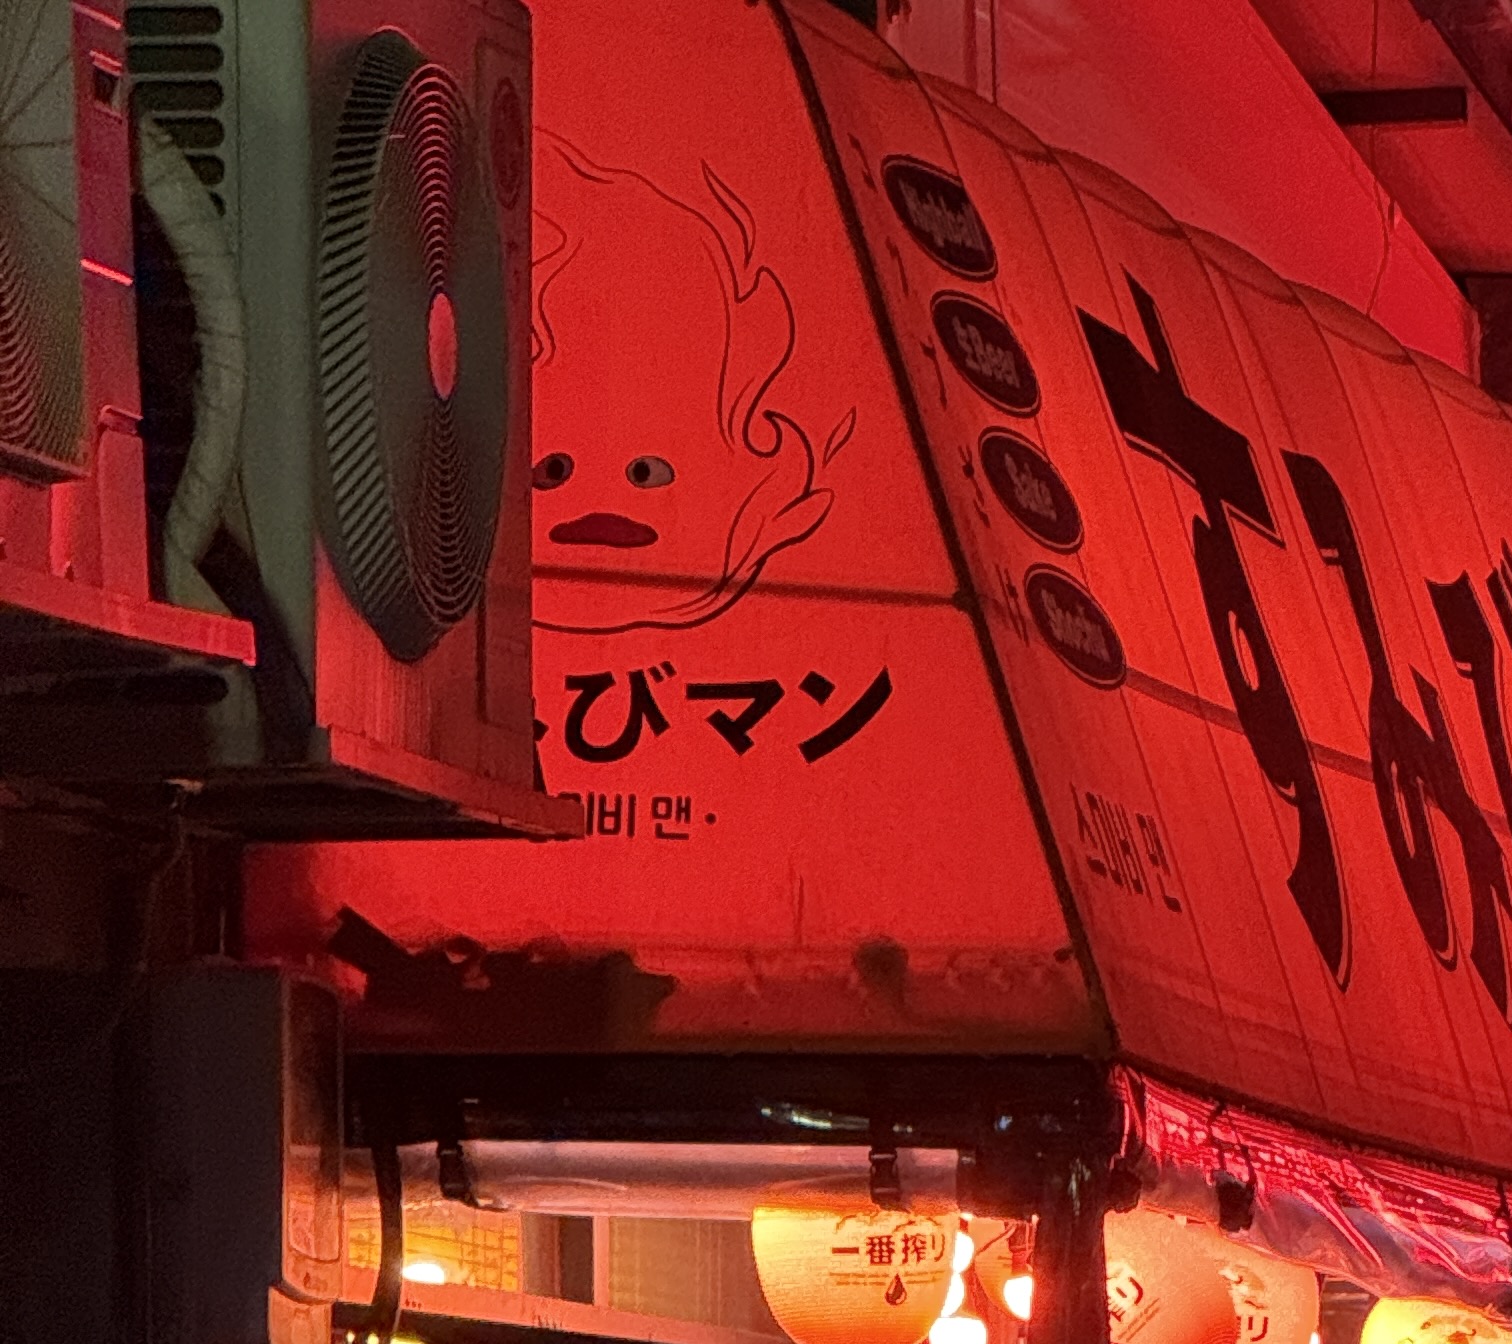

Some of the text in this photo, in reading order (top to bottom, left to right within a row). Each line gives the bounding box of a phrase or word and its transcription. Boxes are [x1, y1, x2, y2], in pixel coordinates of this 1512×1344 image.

[533, 661, 893, 766] びマン
[831, 1233, 946, 1266] 一番搾り
